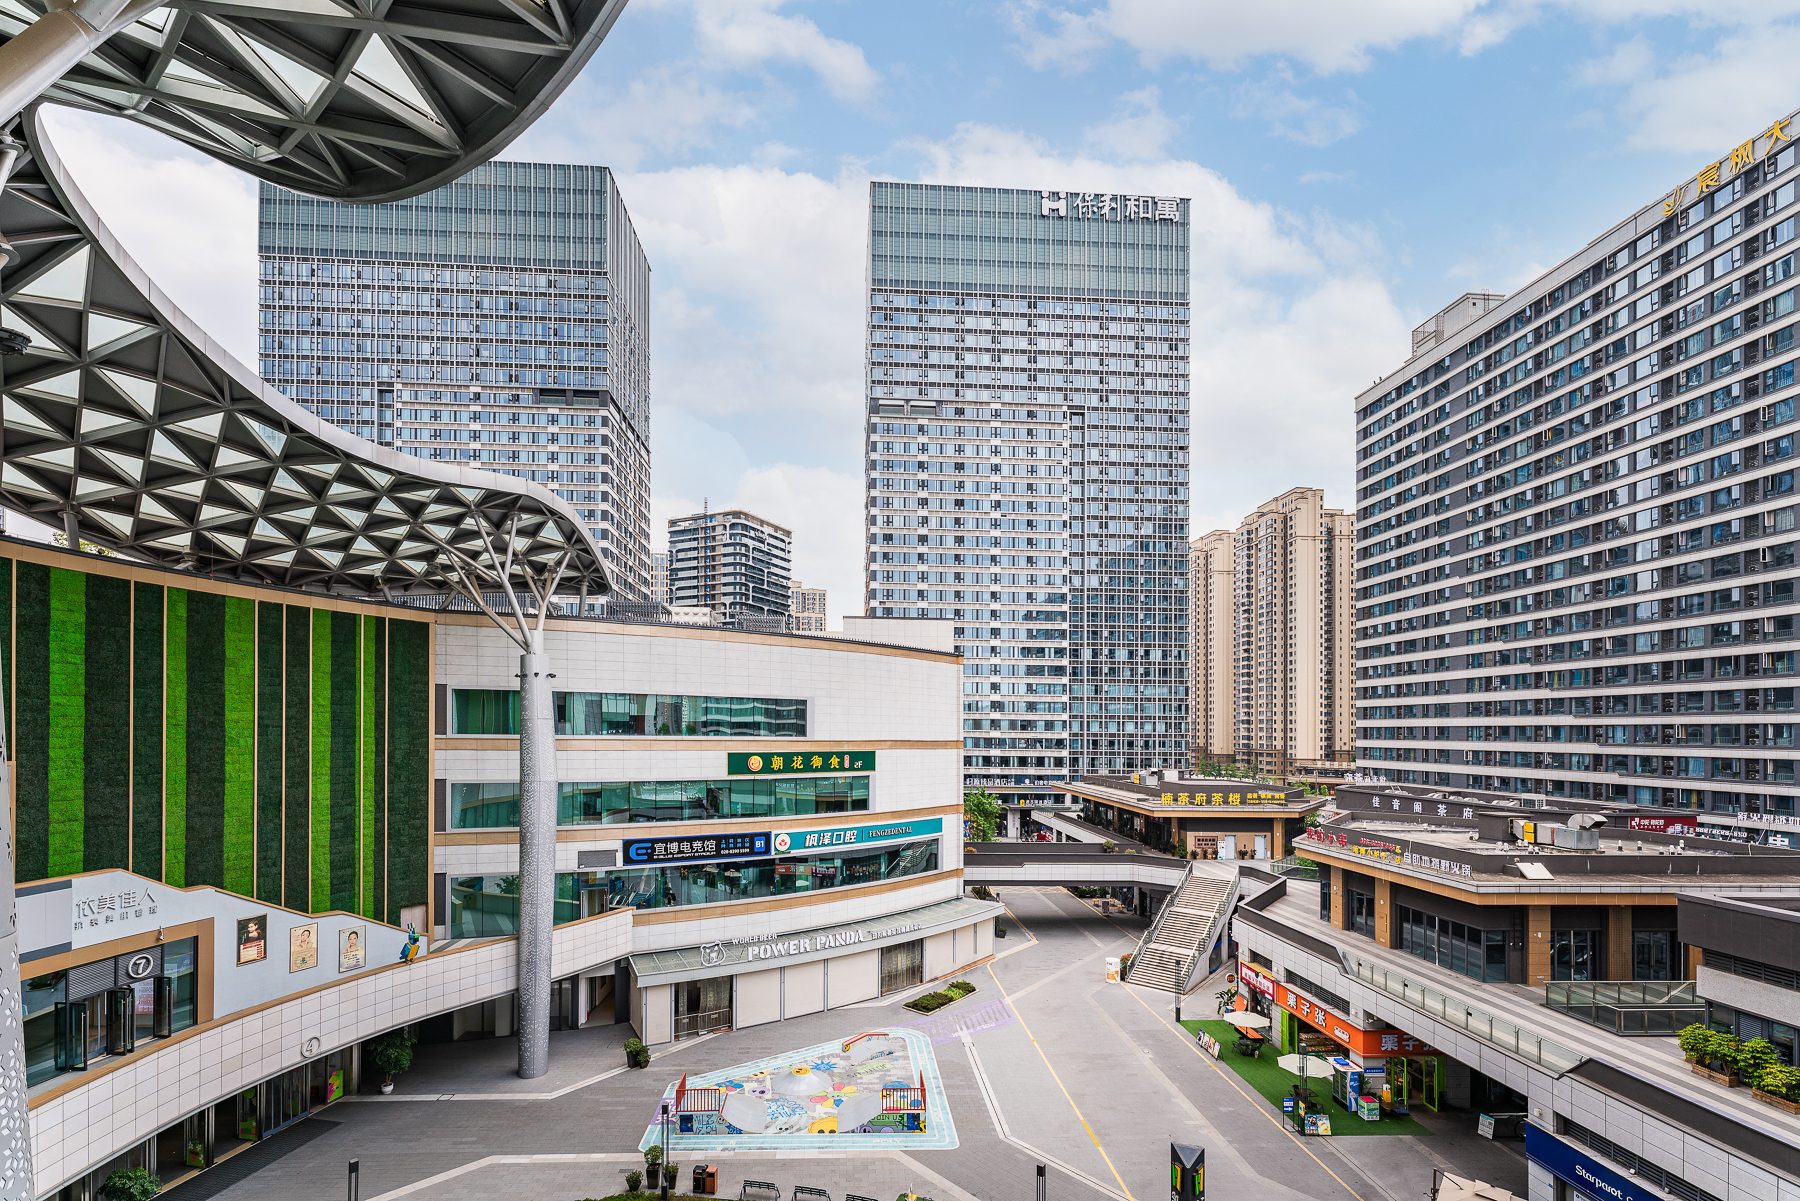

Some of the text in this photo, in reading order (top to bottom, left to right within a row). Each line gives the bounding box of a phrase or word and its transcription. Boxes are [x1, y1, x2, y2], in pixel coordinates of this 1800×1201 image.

[1073, 192, 1180, 223] 保利和寓
[770, 754, 841, 771] 朝花御食
[653, 839, 717, 855] 宜博电竞馆
[76, 887, 156, 919] 依美佳人
[747, 939, 811, 962] POWER
[815, 930, 864, 951] PANDA
[1286, 990, 1327, 1029] 栗子张
